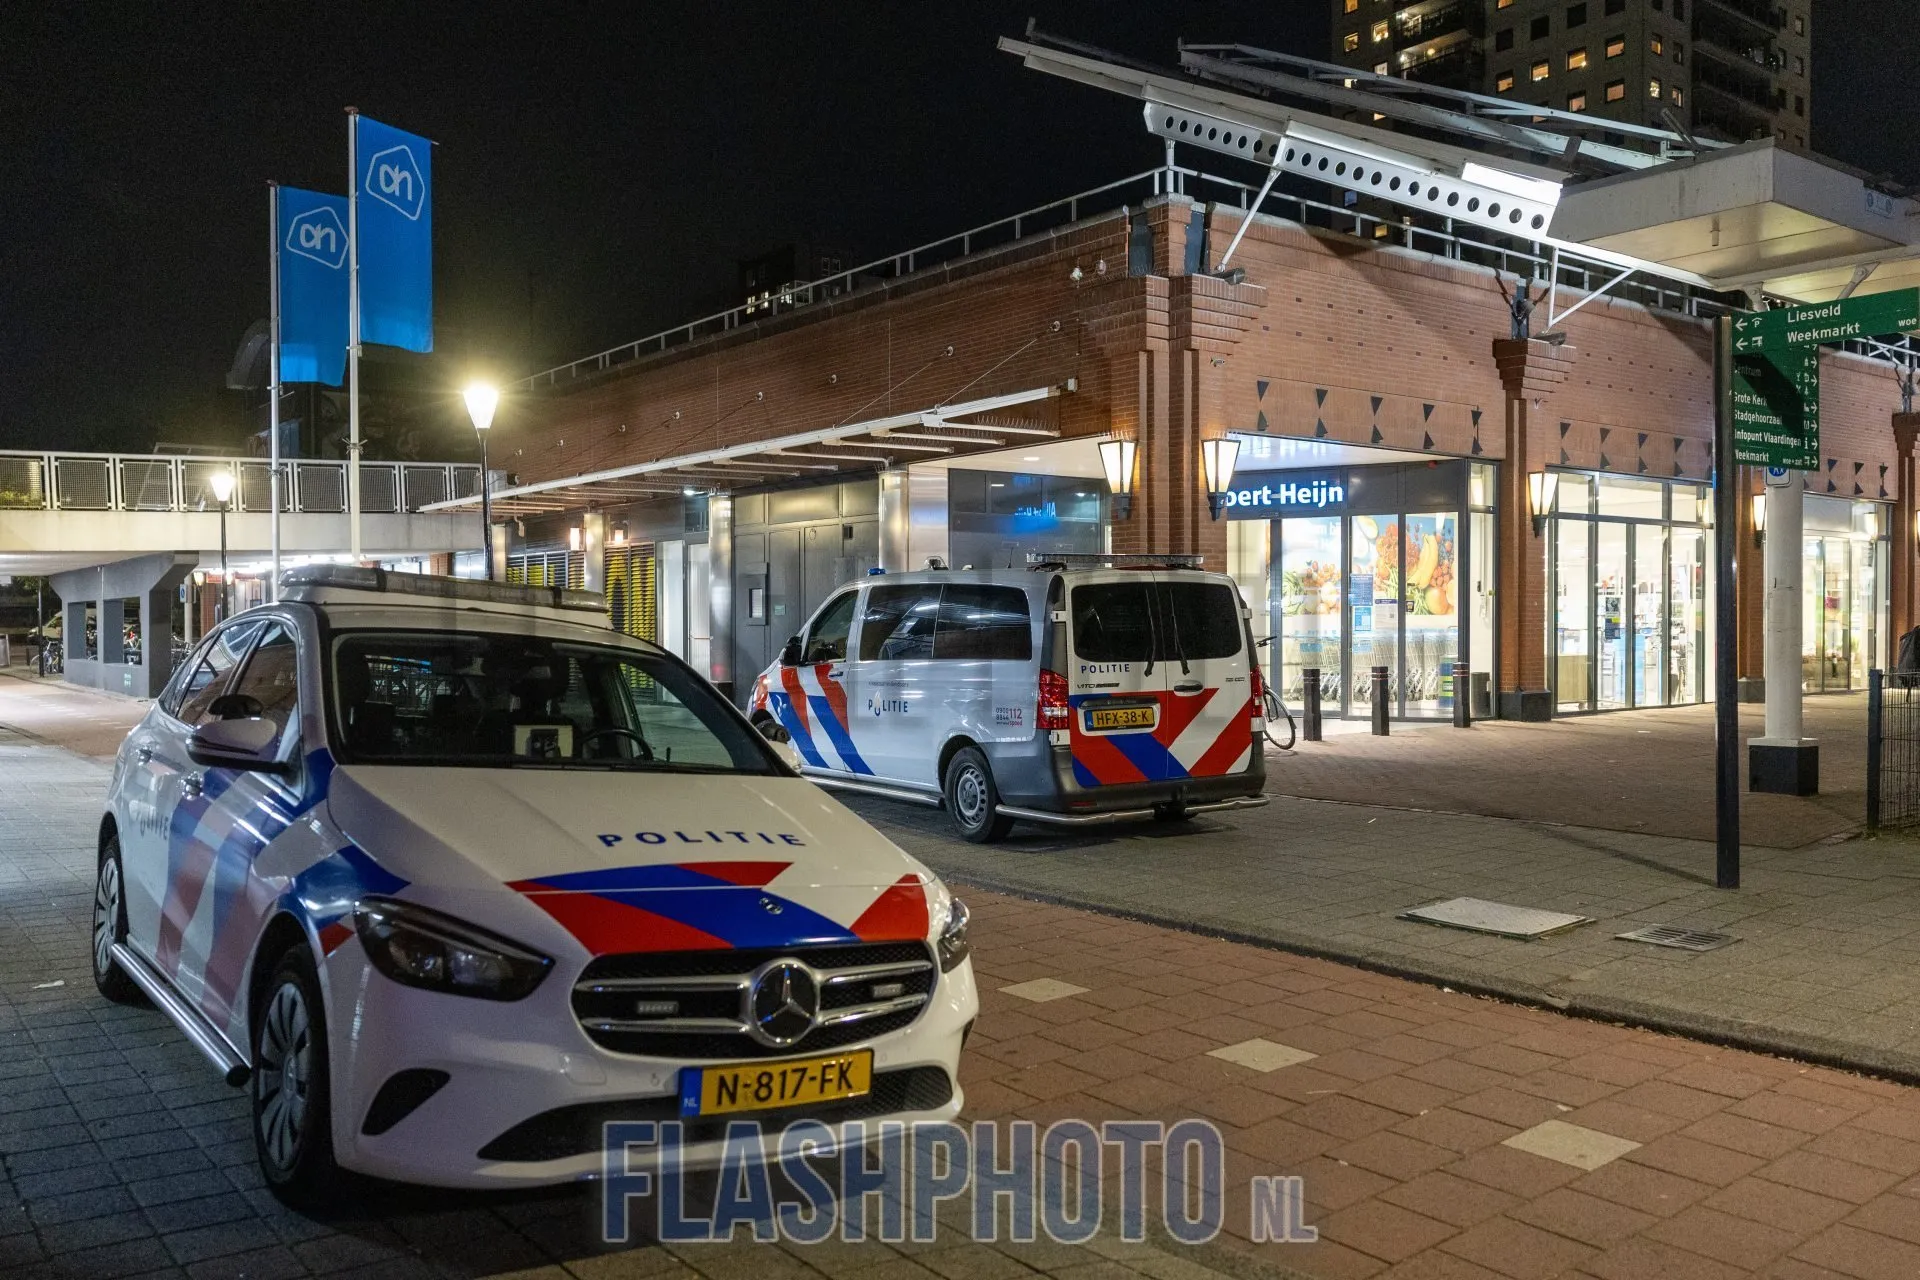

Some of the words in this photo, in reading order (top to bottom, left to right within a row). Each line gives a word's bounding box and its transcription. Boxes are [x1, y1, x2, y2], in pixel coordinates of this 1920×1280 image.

[1787, 304, 1841, 324] Liesveld
[1787, 322, 1861, 344] Weekmarkt
[1898, 317, 1917, 327] woe
[1763, 432, 1802, 448] Vlaardingen
[1280, 480, 1343, 507] Heijn
[1081, 663, 1131, 674] POLITIE
[868, 696, 908, 717] POLITIE
[1009, 708, 1023, 719] 112
[1096, 710, 1150, 726] HFX-38-K
[597, 831, 806, 847] POLITIE
[683, 1097, 698, 1108] NL
[716, 1060, 853, 1107] N-817-FK
